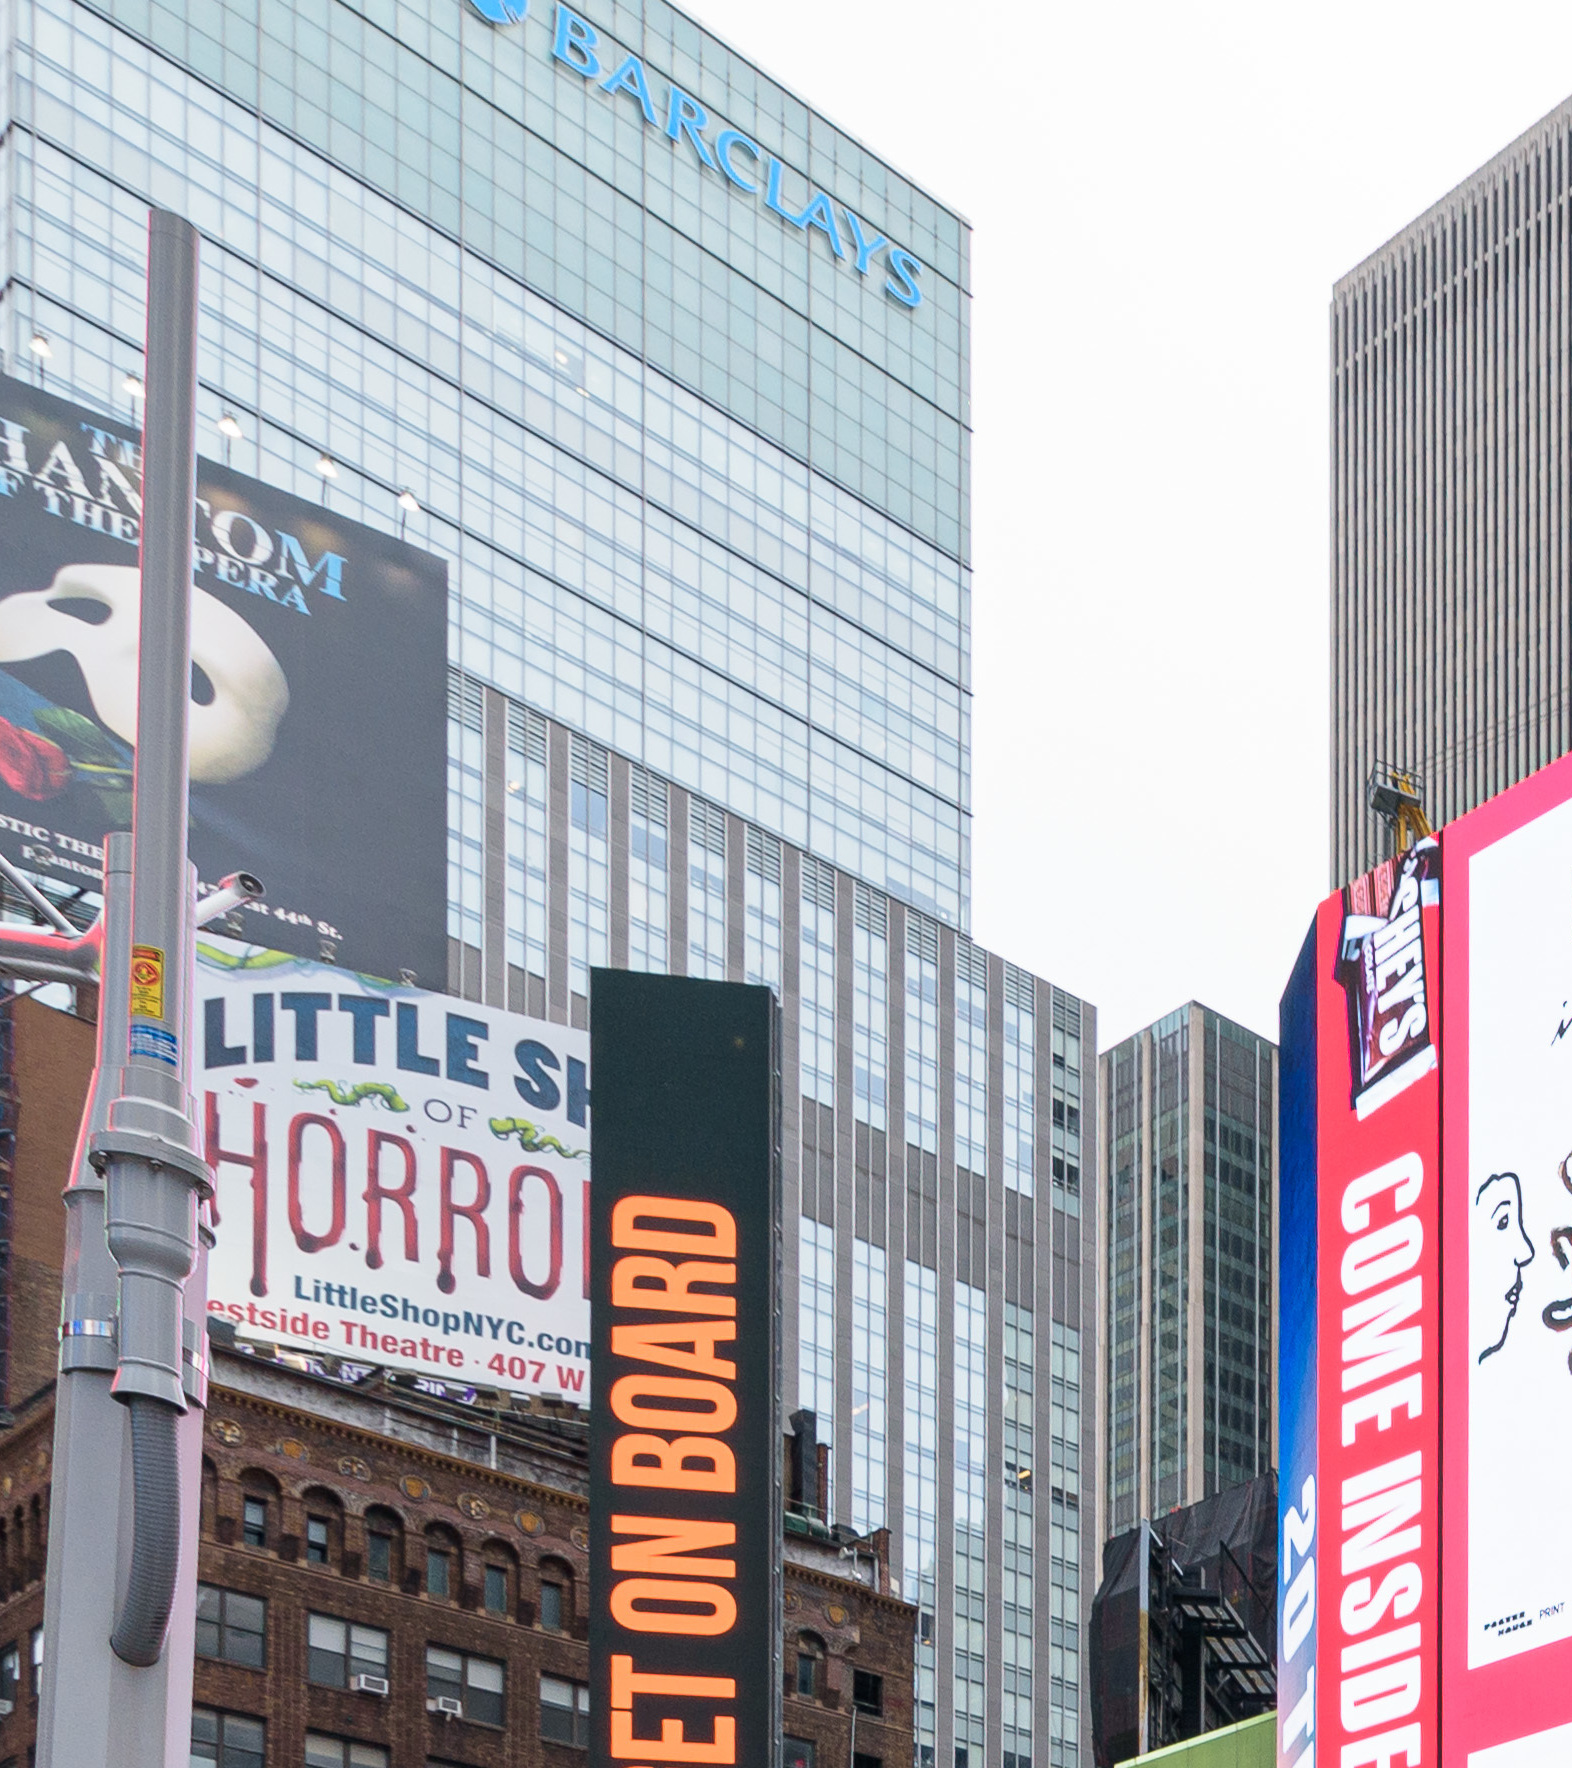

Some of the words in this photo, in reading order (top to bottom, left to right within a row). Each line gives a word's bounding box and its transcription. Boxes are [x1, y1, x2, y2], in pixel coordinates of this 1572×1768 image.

[551, 4, 924, 309] BARCLAYS
[33, 480, 140, 546] THE
[193, 539, 312, 617] PERA
[204, 991, 489, 1091] LITTLE
[514, 1037, 591, 1129] SH
[423, 1098, 478, 1130] OF
[206, 1088, 591, 1300] HORRO
[206, 1299, 330, 1339] estside
[341, 1320, 465, 1367] Theatre
[487, 1353, 546, 1385] 407
[610, 1194, 738, 1493] BOARD
[1340, 1150, 1424, 1448] COME
[610, 1513, 738, 1636] ON
